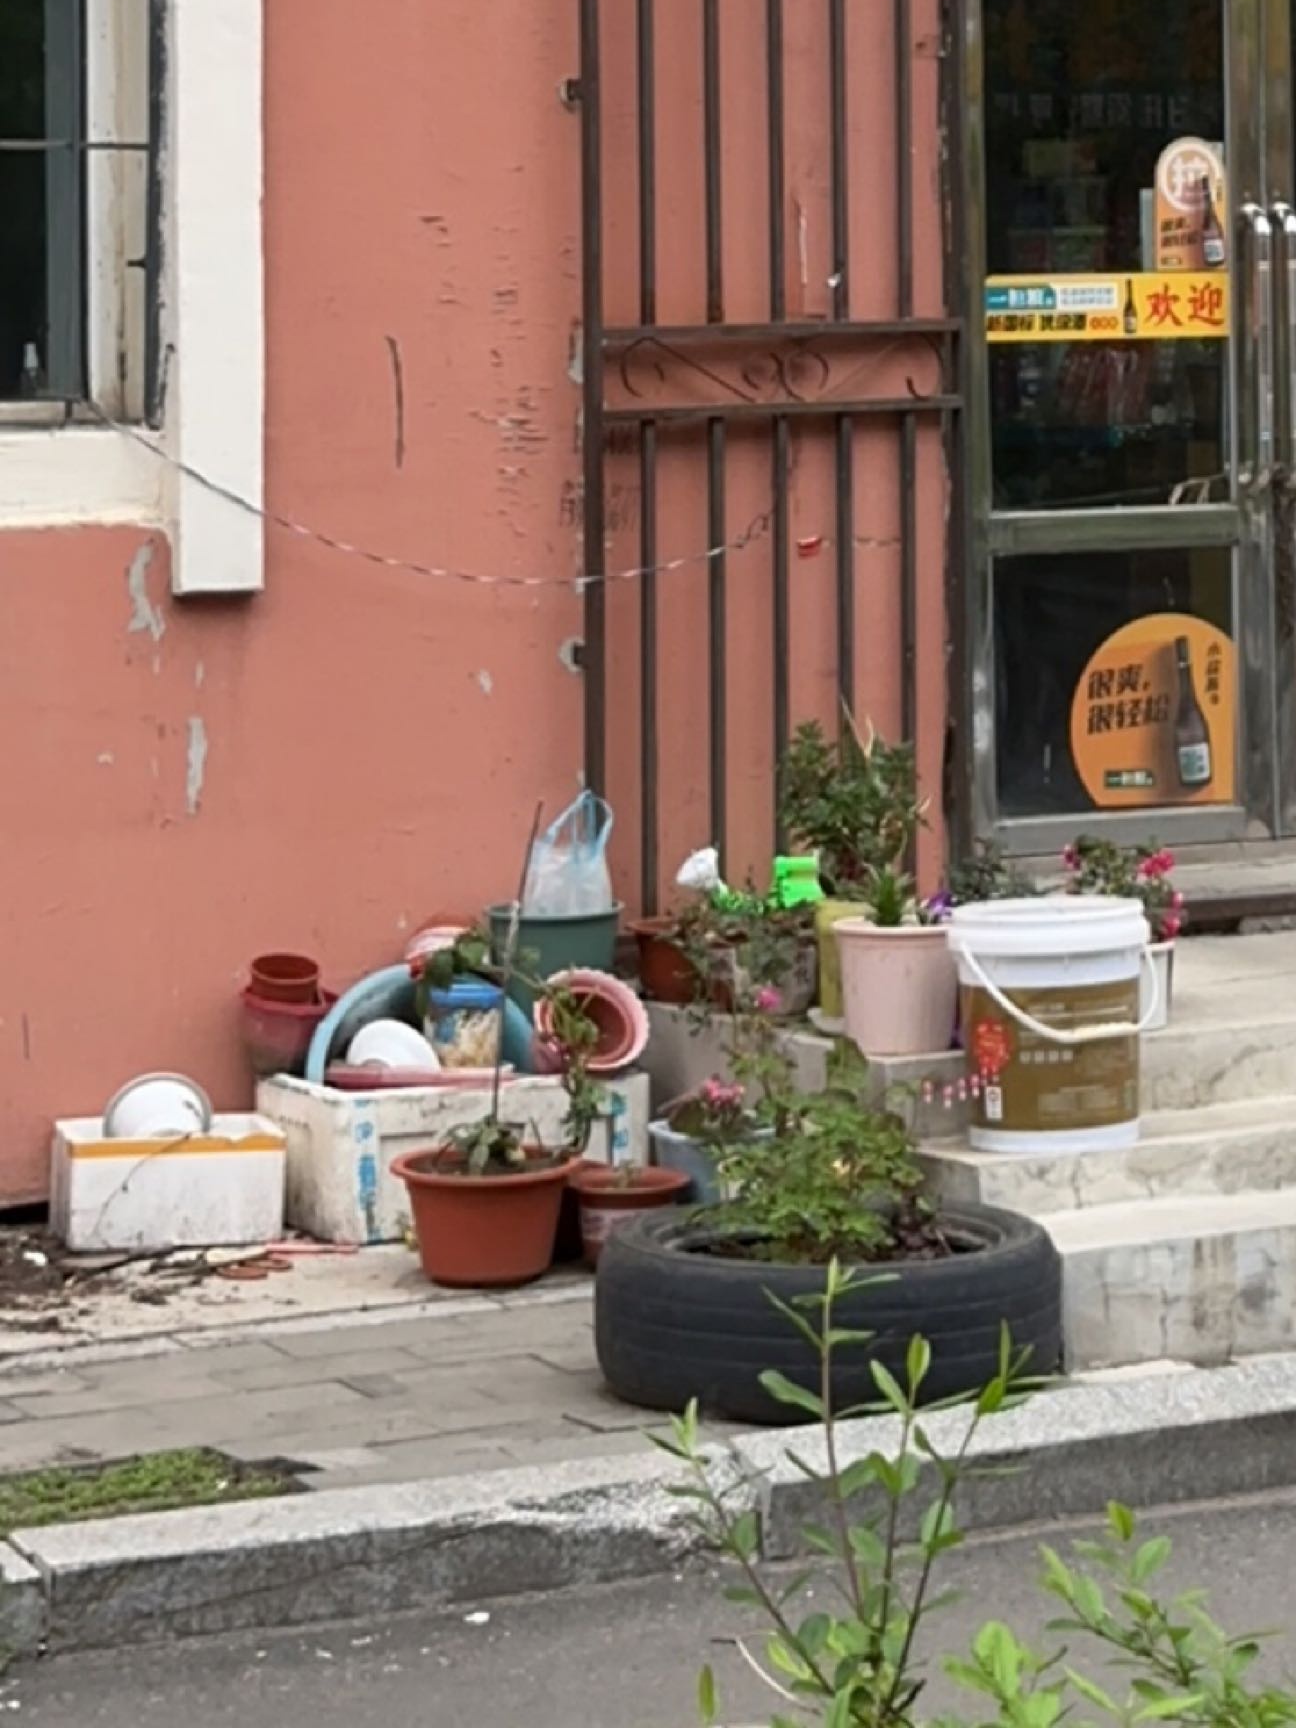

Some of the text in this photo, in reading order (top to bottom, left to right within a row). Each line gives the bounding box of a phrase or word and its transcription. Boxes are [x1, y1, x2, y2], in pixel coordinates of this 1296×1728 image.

[1146, 282, 1225, 327] 欢迎
[1087, 694, 1169, 735] 很轻松
